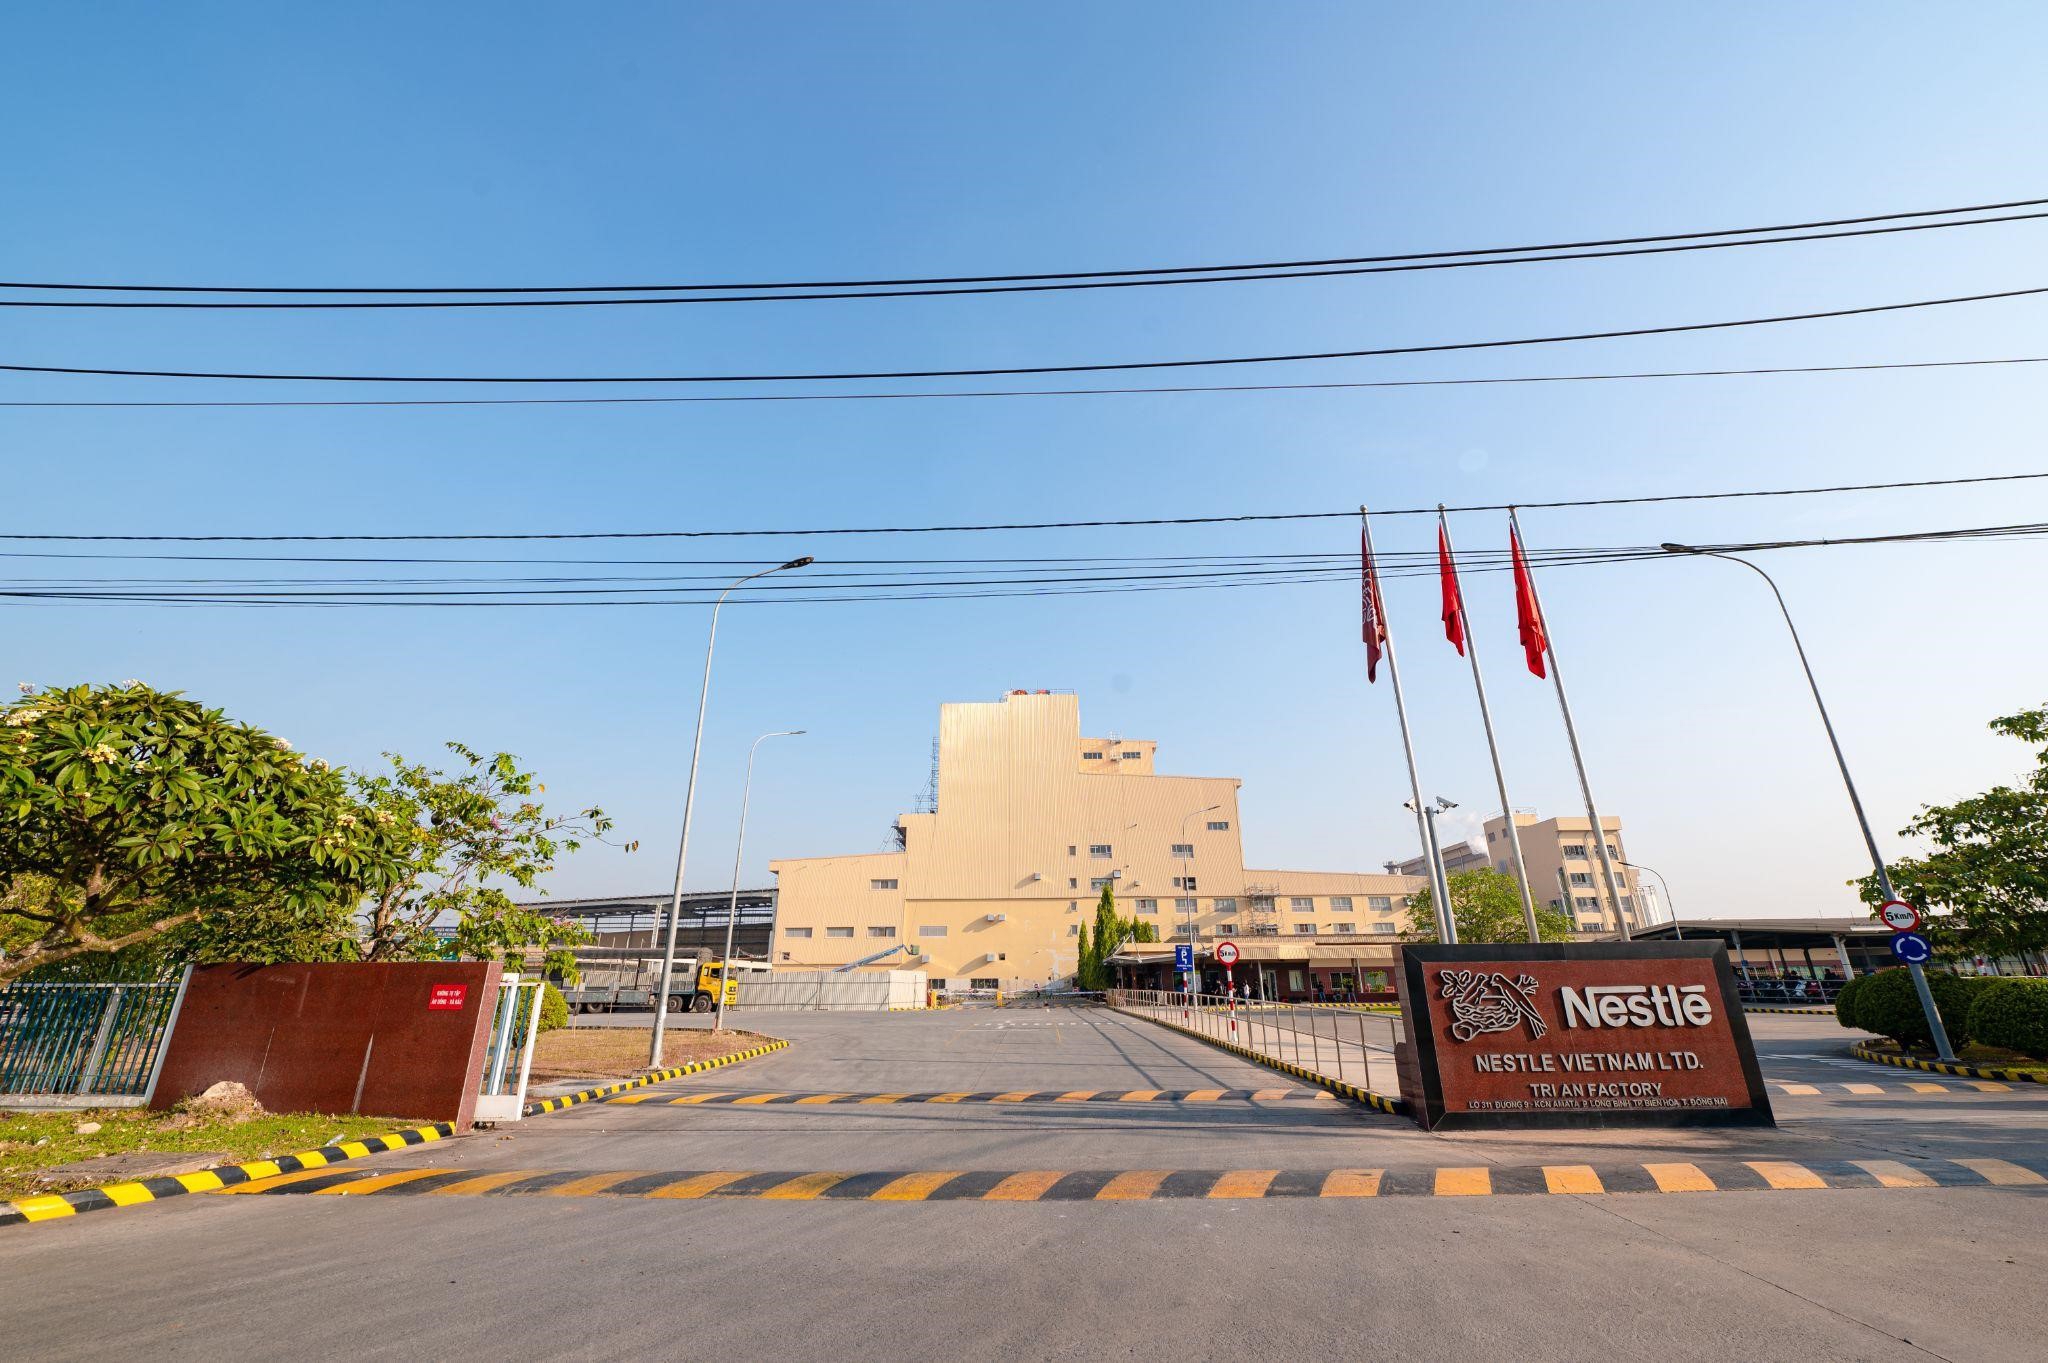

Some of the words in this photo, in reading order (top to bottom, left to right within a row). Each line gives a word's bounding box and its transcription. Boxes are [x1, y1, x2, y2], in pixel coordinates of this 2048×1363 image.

[1475, 1054, 1555, 1072] NESTLE
[1560, 1053, 1654, 1071] VIETNAM
[1657, 1051, 1704, 1070] LTD.
[1530, 1083, 1556, 1097] TRI
[1562, 1083, 1584, 1097] AN
[1588, 1082, 1662, 1097] FACTORY
[1481, 1100, 1492, 1109] 311
[1524, 1100, 1529, 1109] 9
[1534, 1100, 1552, 1108] KCN
[1590, 1099, 1612, 1107] LONG
